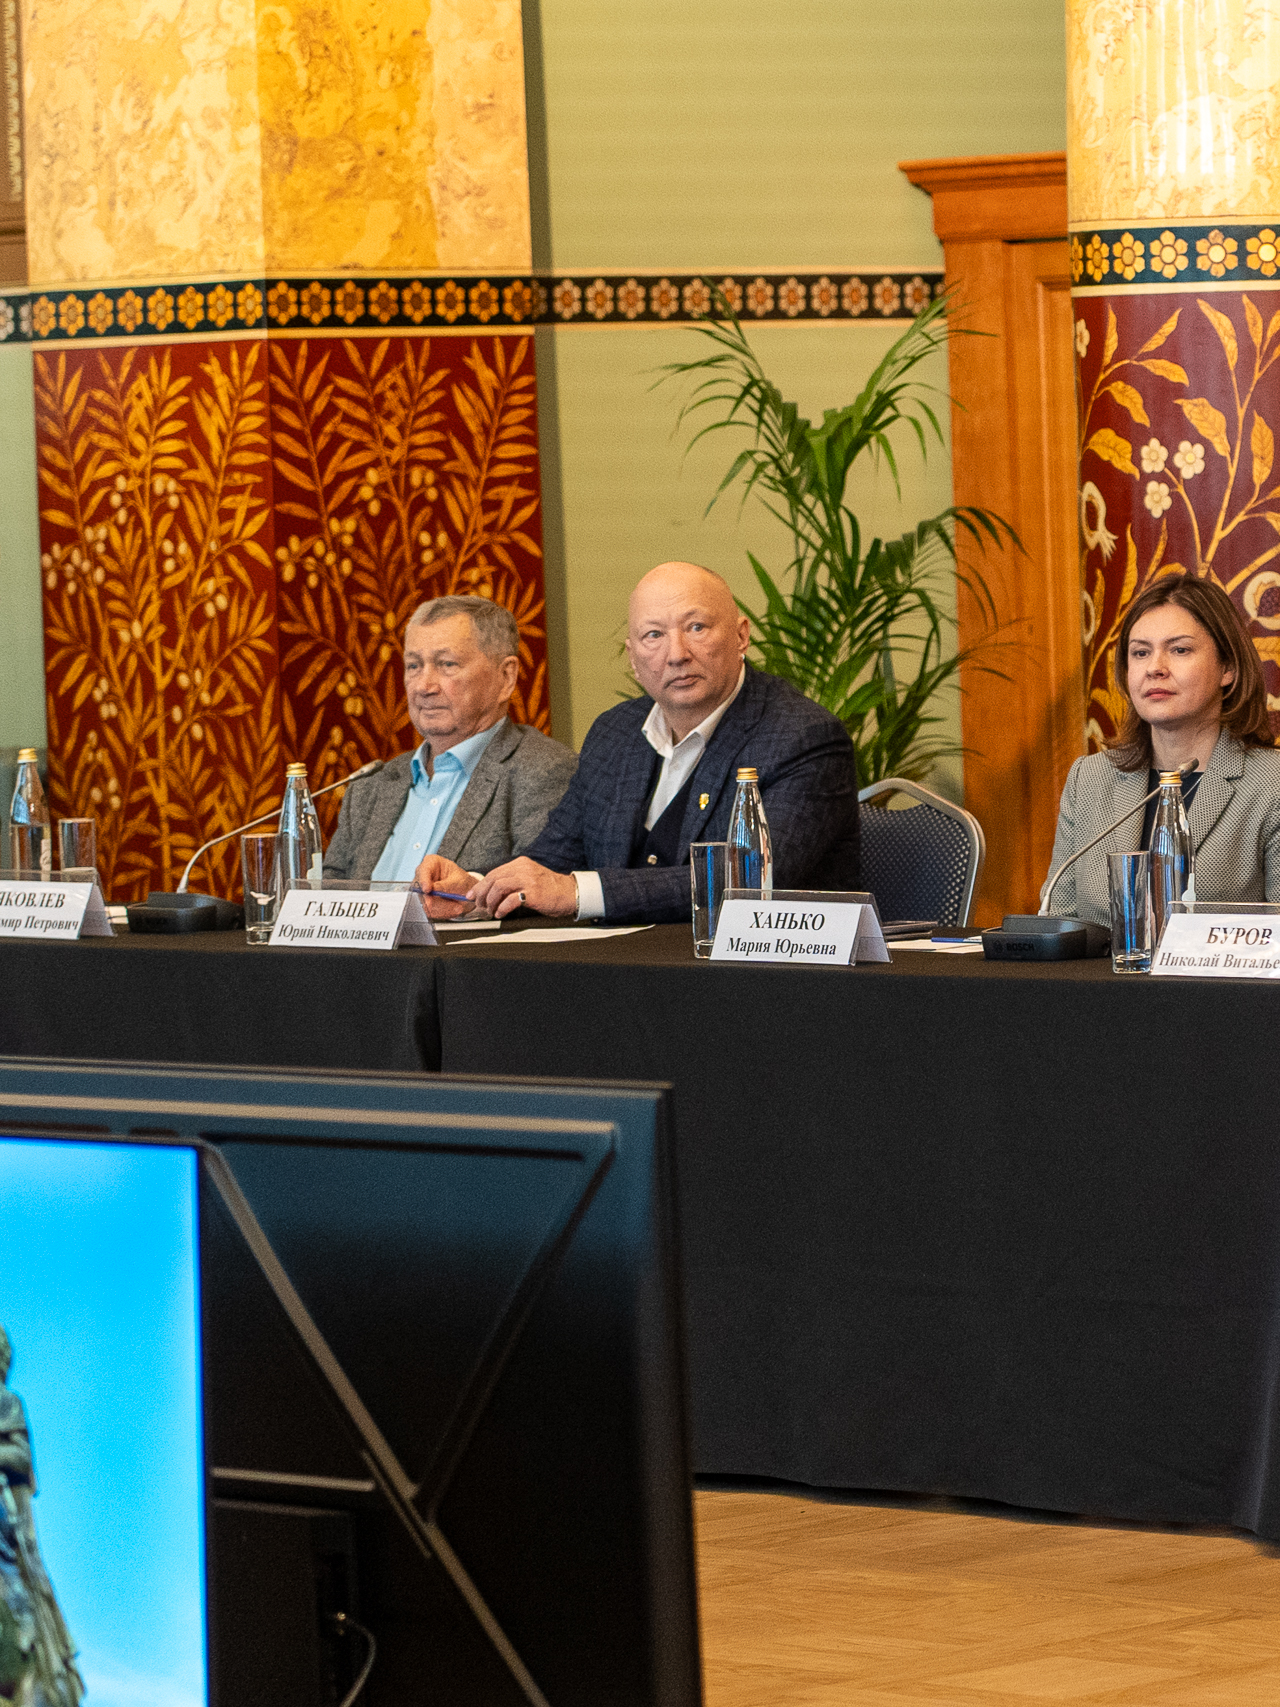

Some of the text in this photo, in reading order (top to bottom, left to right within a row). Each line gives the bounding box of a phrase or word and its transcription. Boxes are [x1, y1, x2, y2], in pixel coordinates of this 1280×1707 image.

[303, 901, 379, 920] ГАЛЬЦЕВ
[24, 915, 79, 932] Петрович
[749, 911, 826, 930] ХАНЬКО
[278, 924, 390, 941] Юрий Николаевич
[1206, 926, 1273, 945] БУРОВ
[726, 937, 837, 957] Мария Юрьевна
[1006, 942, 1035, 951] BOSCH
[1158, 952, 1221, 968] Николай
